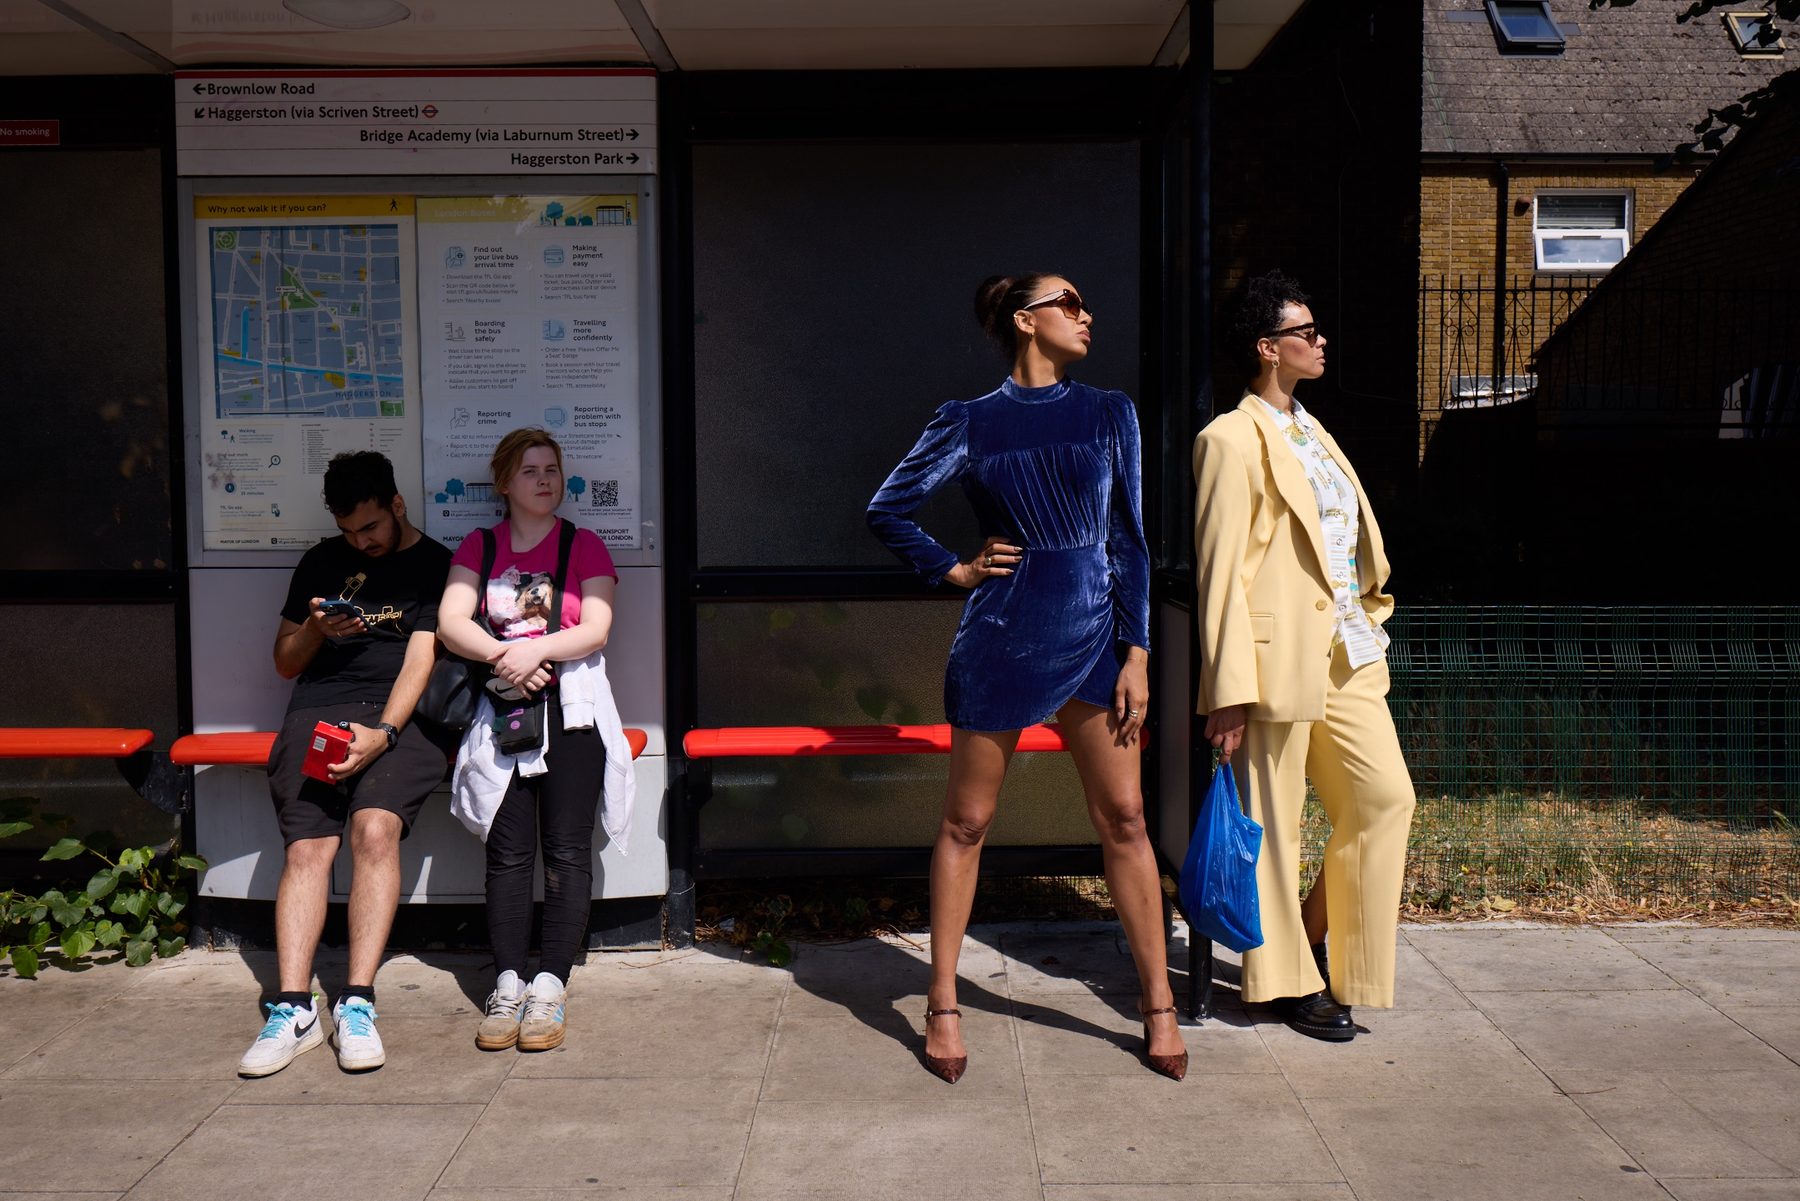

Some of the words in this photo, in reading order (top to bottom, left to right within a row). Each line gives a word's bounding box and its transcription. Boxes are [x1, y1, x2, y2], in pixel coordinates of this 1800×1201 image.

[208, 84, 276, 94] Brownlow
[281, 84, 314, 94] Road
[209, 107, 287, 121] Haggerston
[292, 105, 314, 118] (via
[319, 106, 367, 117] Scriven
[372, 105, 418, 118] Street)
[16, 128, 50, 136] smoking
[360, 130, 403, 144] Bridge
[408, 130, 471, 143] Academy
[476, 129, 498, 142] (via
[504, 130, 573, 141] Laburnum
[578, 129, 624, 142] Street)
[512, 153, 589, 165] Haggerston
[595, 153, 623, 164] Park
[208, 206, 228, 214] Why
